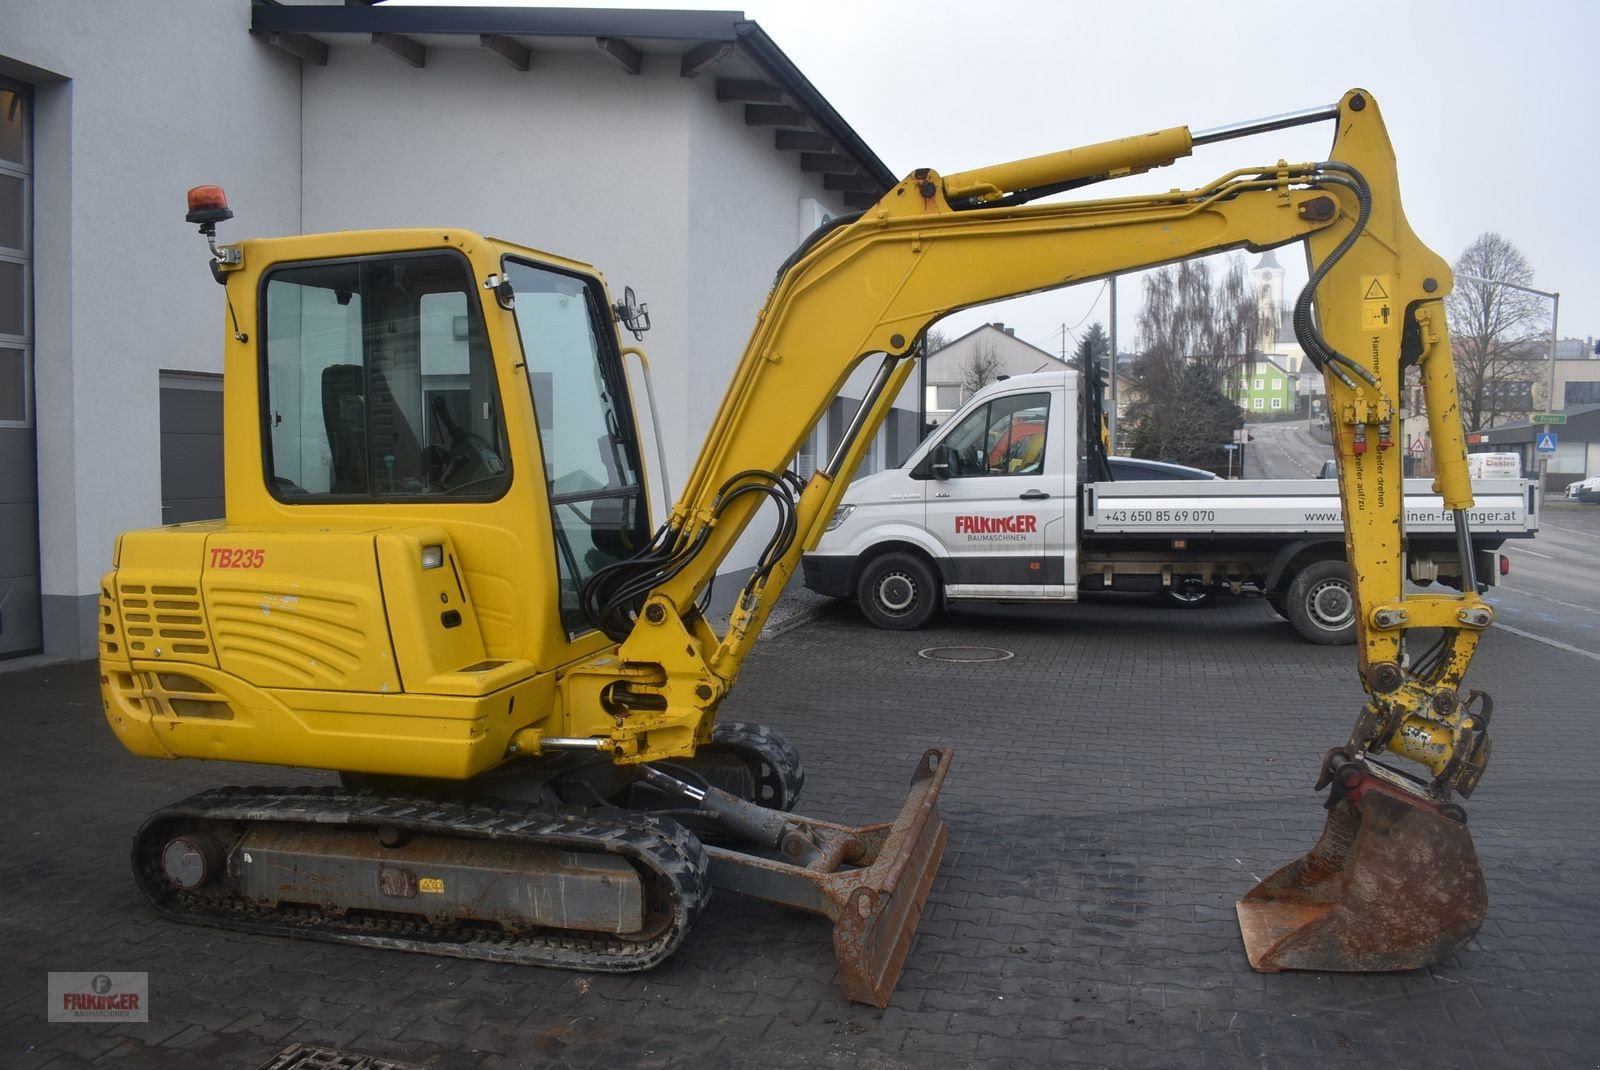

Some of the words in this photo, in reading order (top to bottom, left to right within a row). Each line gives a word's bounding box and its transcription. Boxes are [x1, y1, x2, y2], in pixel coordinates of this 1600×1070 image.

[1372, 336, 1380, 374] Hammer
[1354, 454, 1364, 481] reifer
[1377, 477, 1385, 508] drehen
[955, 515, 1037, 534] FALKINGER
[1105, 511, 1127, 522] +43
[1130, 511, 1152, 522] 650
[1155, 511, 1170, 522] 85
[1174, 511, 1189, 522] 69
[1192, 511, 1215, 522] 070
[967, 534, 1027, 542] BAUMASCHINEN
[210, 548, 266, 569] TB235
